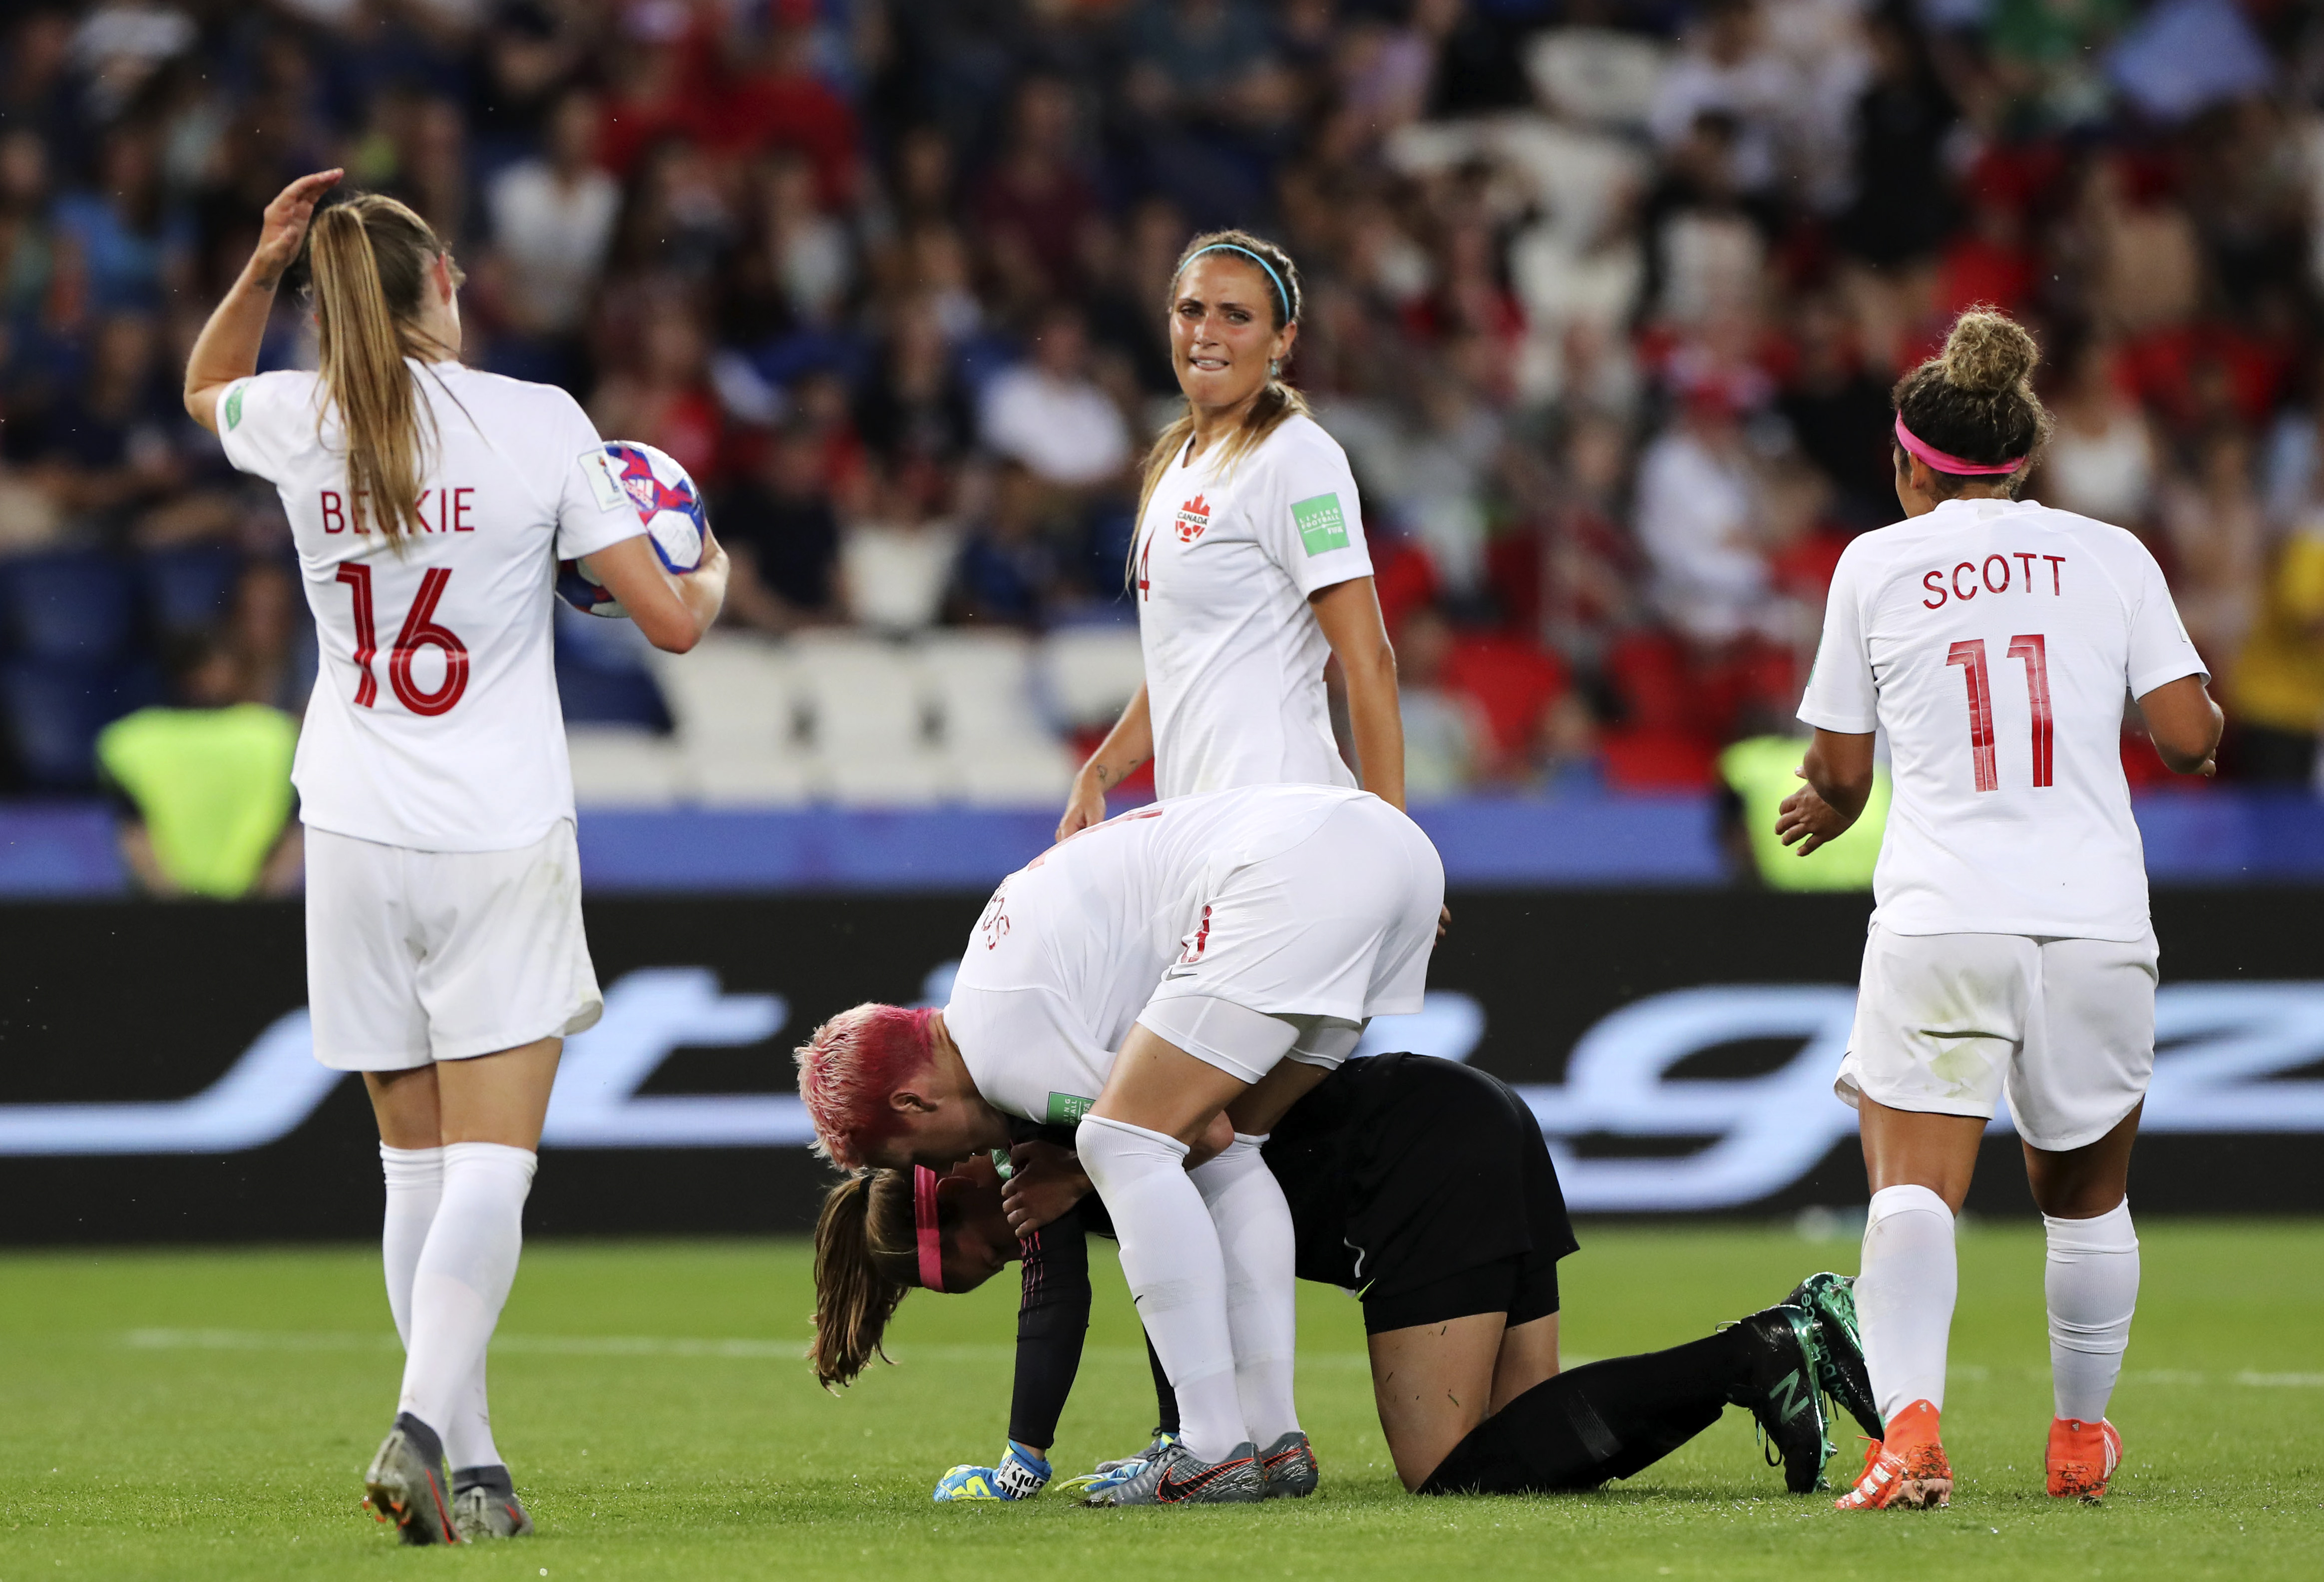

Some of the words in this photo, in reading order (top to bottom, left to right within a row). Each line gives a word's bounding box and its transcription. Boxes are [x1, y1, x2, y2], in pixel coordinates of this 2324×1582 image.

[1177, 512, 1207, 525] CANADA
[1299, 507, 1339, 523] LIVING
[1301, 514, 1340, 530] FOOTBALL
[1923, 552, 2066, 609] SCOTT
[337, 562, 469, 717] 16
[1946, 634, 2053, 792] 11
[1768, 1368, 1810, 1424] N
